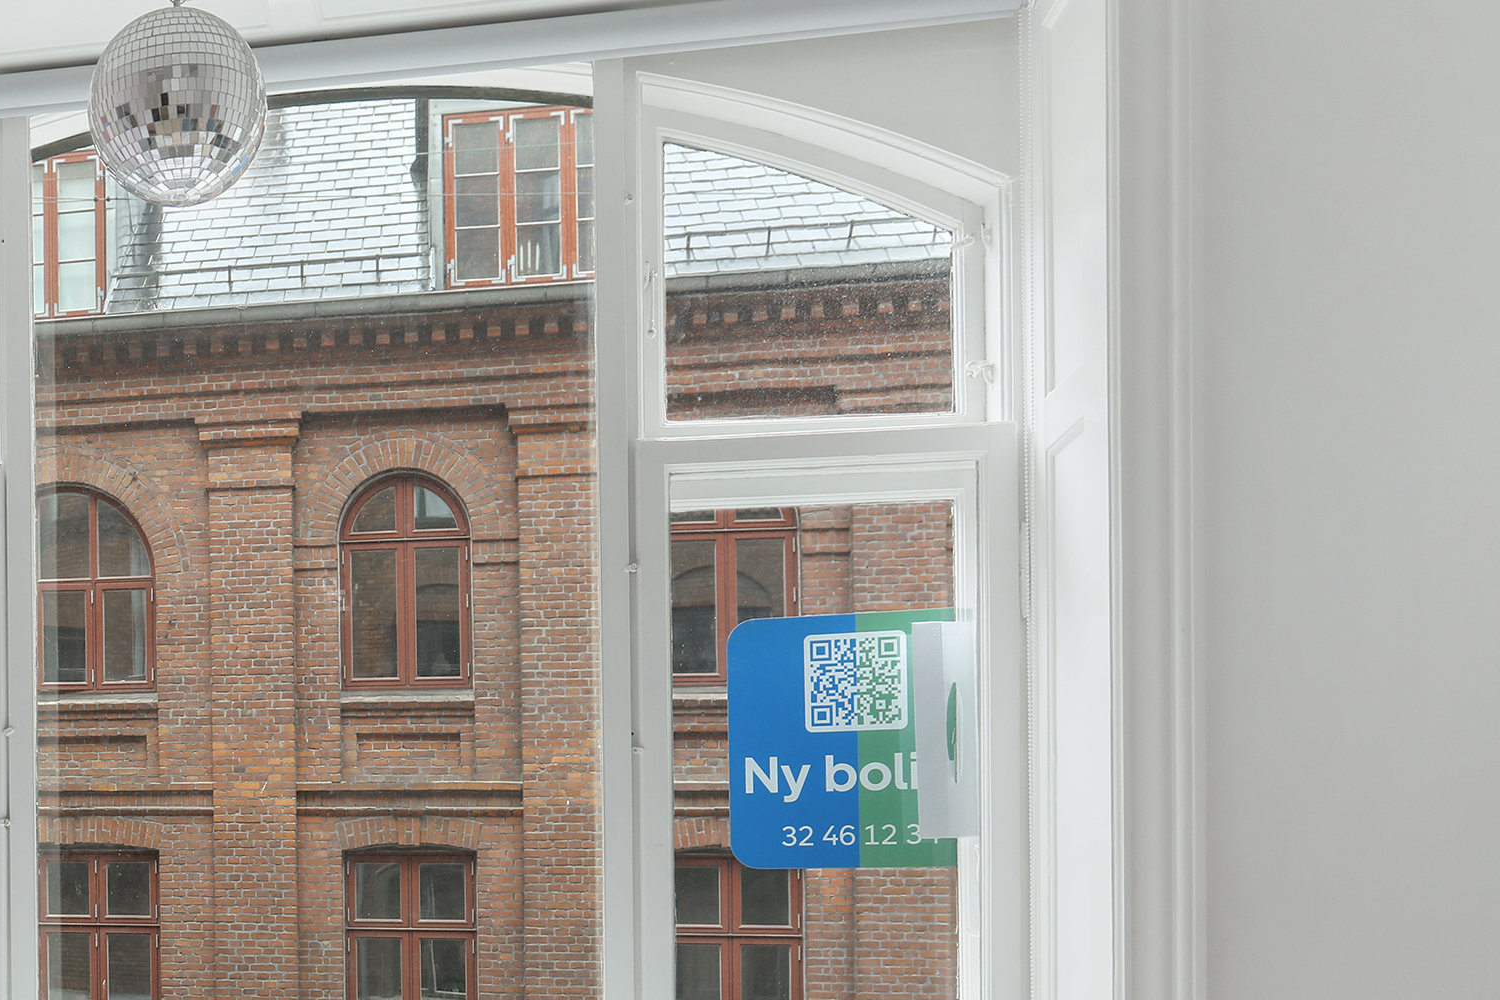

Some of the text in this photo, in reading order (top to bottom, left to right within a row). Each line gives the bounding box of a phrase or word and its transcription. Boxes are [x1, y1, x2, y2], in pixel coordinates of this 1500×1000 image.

[744, 752, 918, 803] Ny boli
[781, 823, 938, 847] 32 46 12 3
